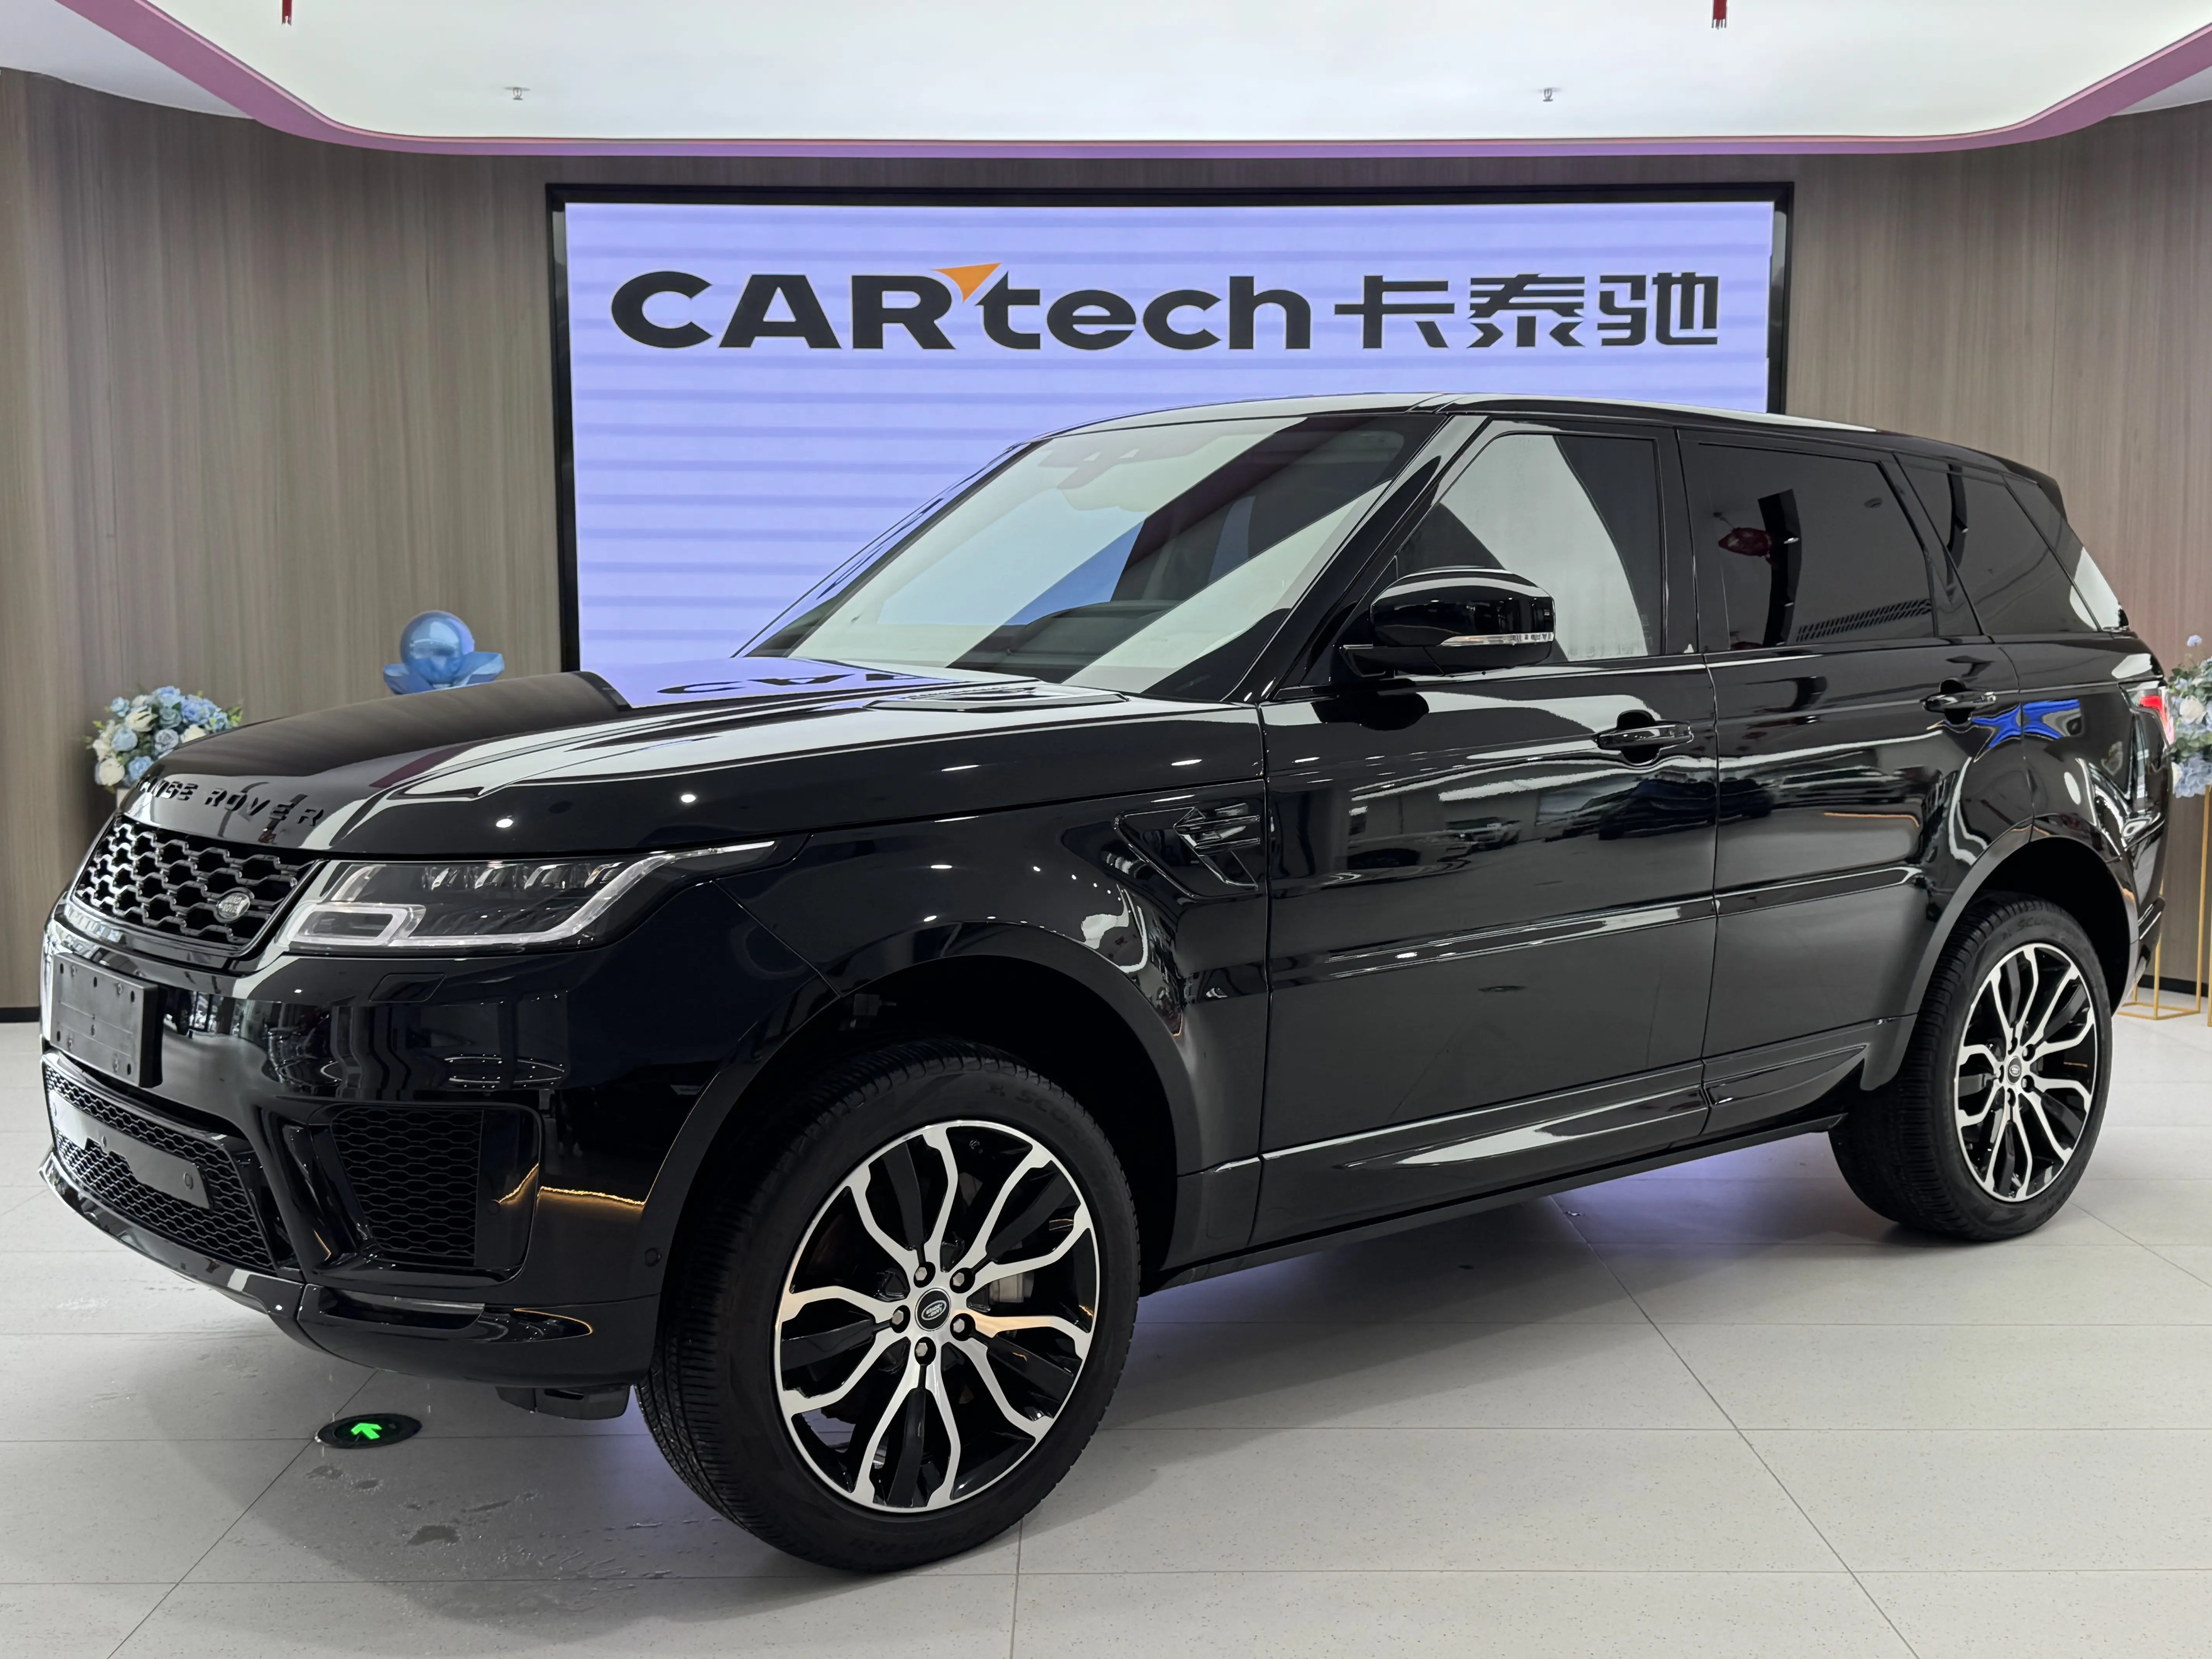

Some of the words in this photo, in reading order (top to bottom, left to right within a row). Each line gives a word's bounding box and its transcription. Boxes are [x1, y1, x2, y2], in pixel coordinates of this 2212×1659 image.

[612, 268, 1310, 350] CARtech
[1335, 273, 1718, 348] 卡泰驰
[204, 788, 324, 826] ROVER
